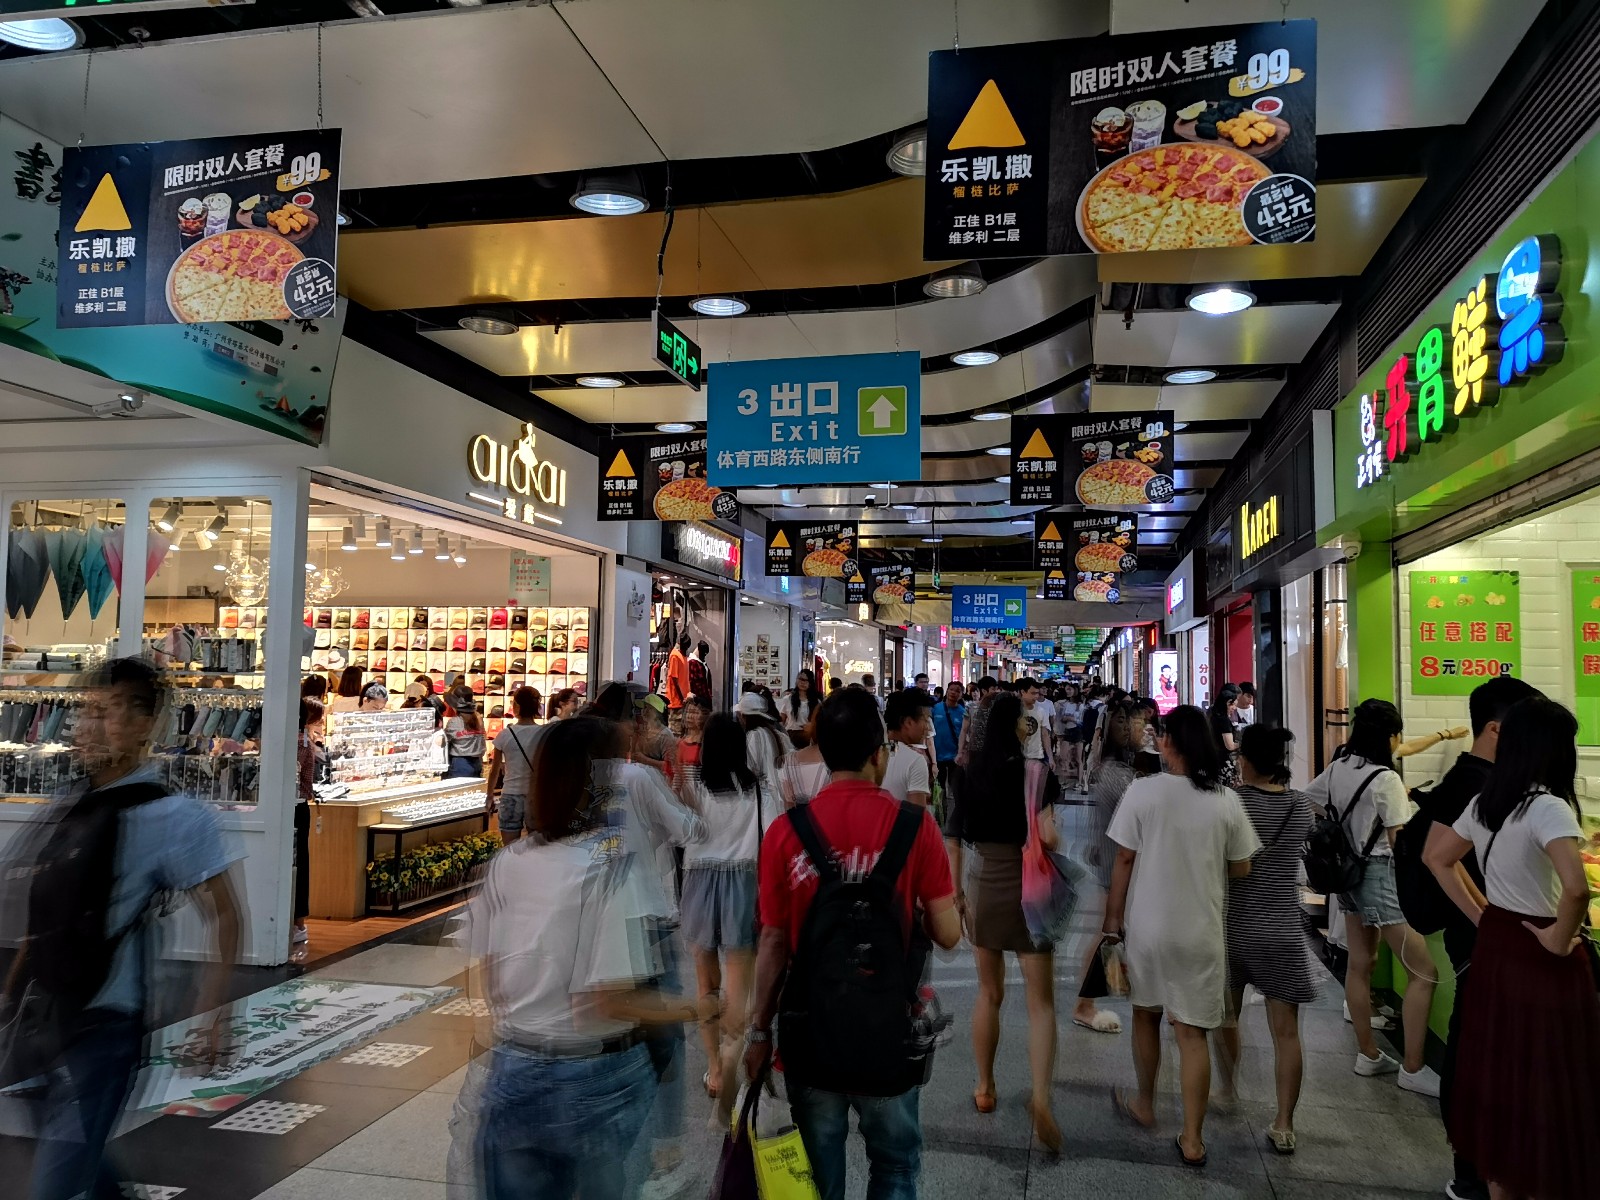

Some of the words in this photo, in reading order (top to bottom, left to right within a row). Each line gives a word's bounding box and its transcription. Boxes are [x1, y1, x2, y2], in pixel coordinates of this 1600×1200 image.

[1070, 38, 1237, 97] 限时双人套餐
[164, 143, 285, 189] 限时双人套餐
[940, 153, 1033, 183] 乐凯撒
[953, 214, 980, 228] 正佳
[984, 212, 1017, 226] B1层
[1257, 193, 1313, 228] 42元
[69, 236, 136, 260] 乐凯撒
[948, 229, 989, 245] 维多利
[992, 228, 1021, 242] 二层
[78, 287, 98, 299] 正佳
[100, 286, 125, 298] B1层
[293, 275, 334, 304] 42元
[74, 301, 104, 314] 维多利
[106, 300, 127, 312] 二层
[736, 388, 759, 416] 3
[769, 381, 839, 417] 出口
[771, 420, 839, 443] Exit
[716, 445, 861, 470] 体育西路东侧南行
[1241, 495, 1279, 560] KAREN
[962, 594, 971, 605] 3
[973, 593, 999, 606] 出口
[973, 606, 999, 615] Exit
[1419, 621, 1513, 643] 任意搭配
